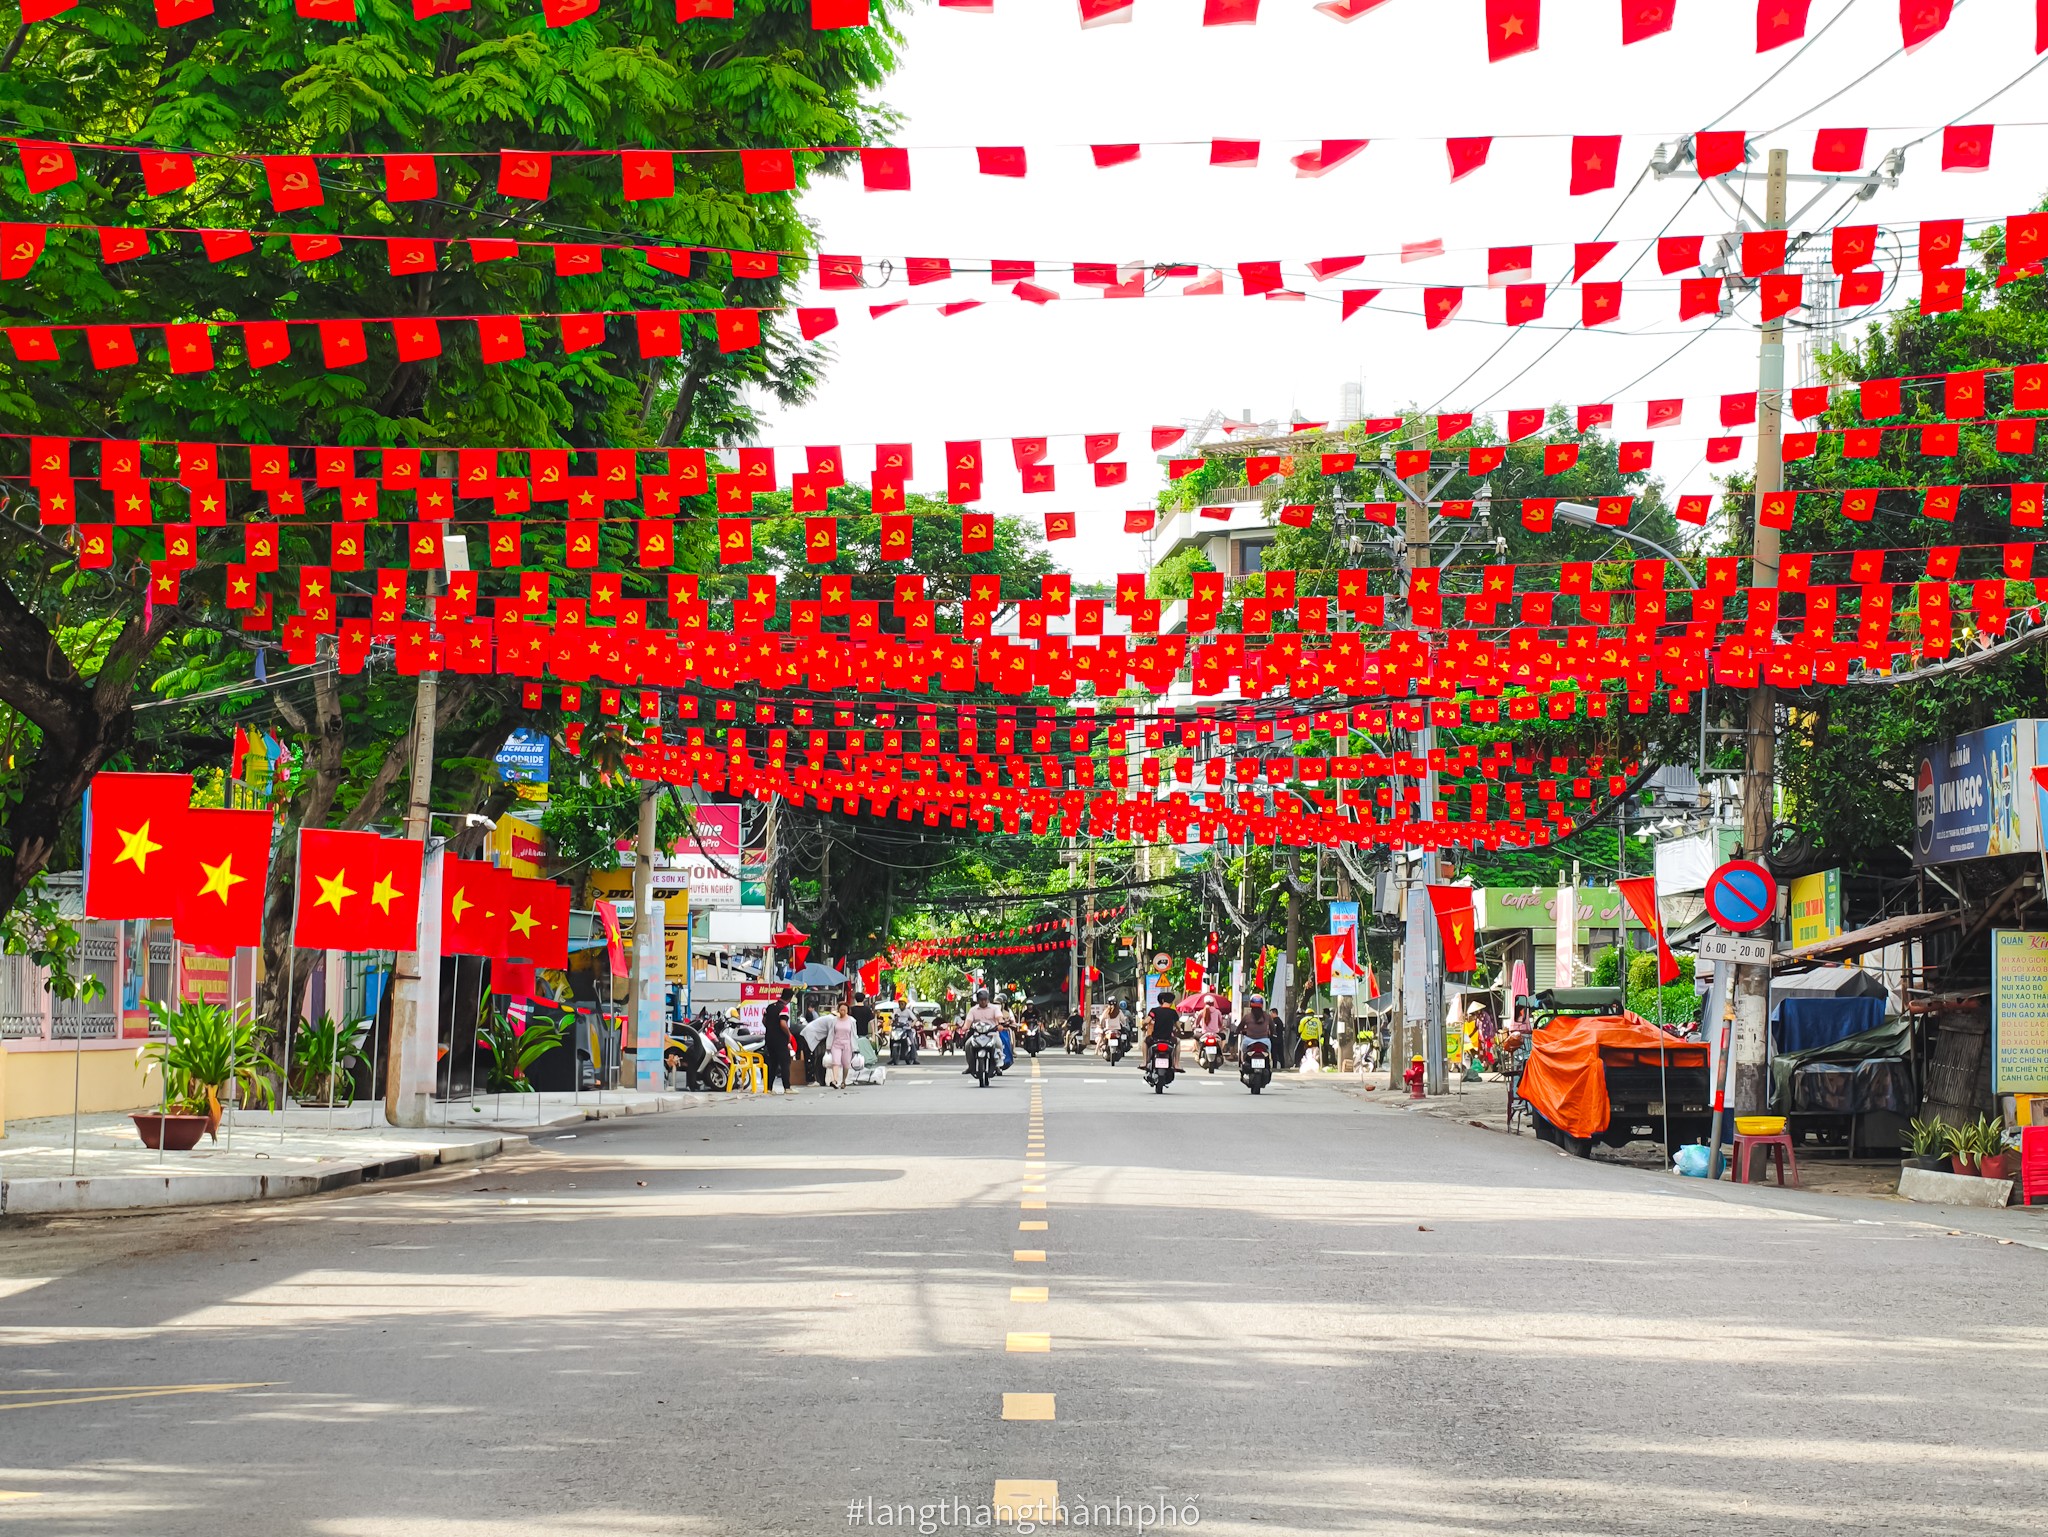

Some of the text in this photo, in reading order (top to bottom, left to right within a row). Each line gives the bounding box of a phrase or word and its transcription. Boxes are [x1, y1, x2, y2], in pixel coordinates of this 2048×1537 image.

[495, 754, 544, 764] GOODRIDE
[1940, 774, 1983, 816] KIM NGỌC
[1918, 794, 1934, 816] PEPSI
[689, 839, 720, 848] biePro
[677, 875, 686, 883] XE
[606, 889, 680, 899] DUOP
[1705, 942, 1727, 954] 6:00
[1740, 945, 1765, 958] 20:00
[759, 986, 784, 995] Havolin
